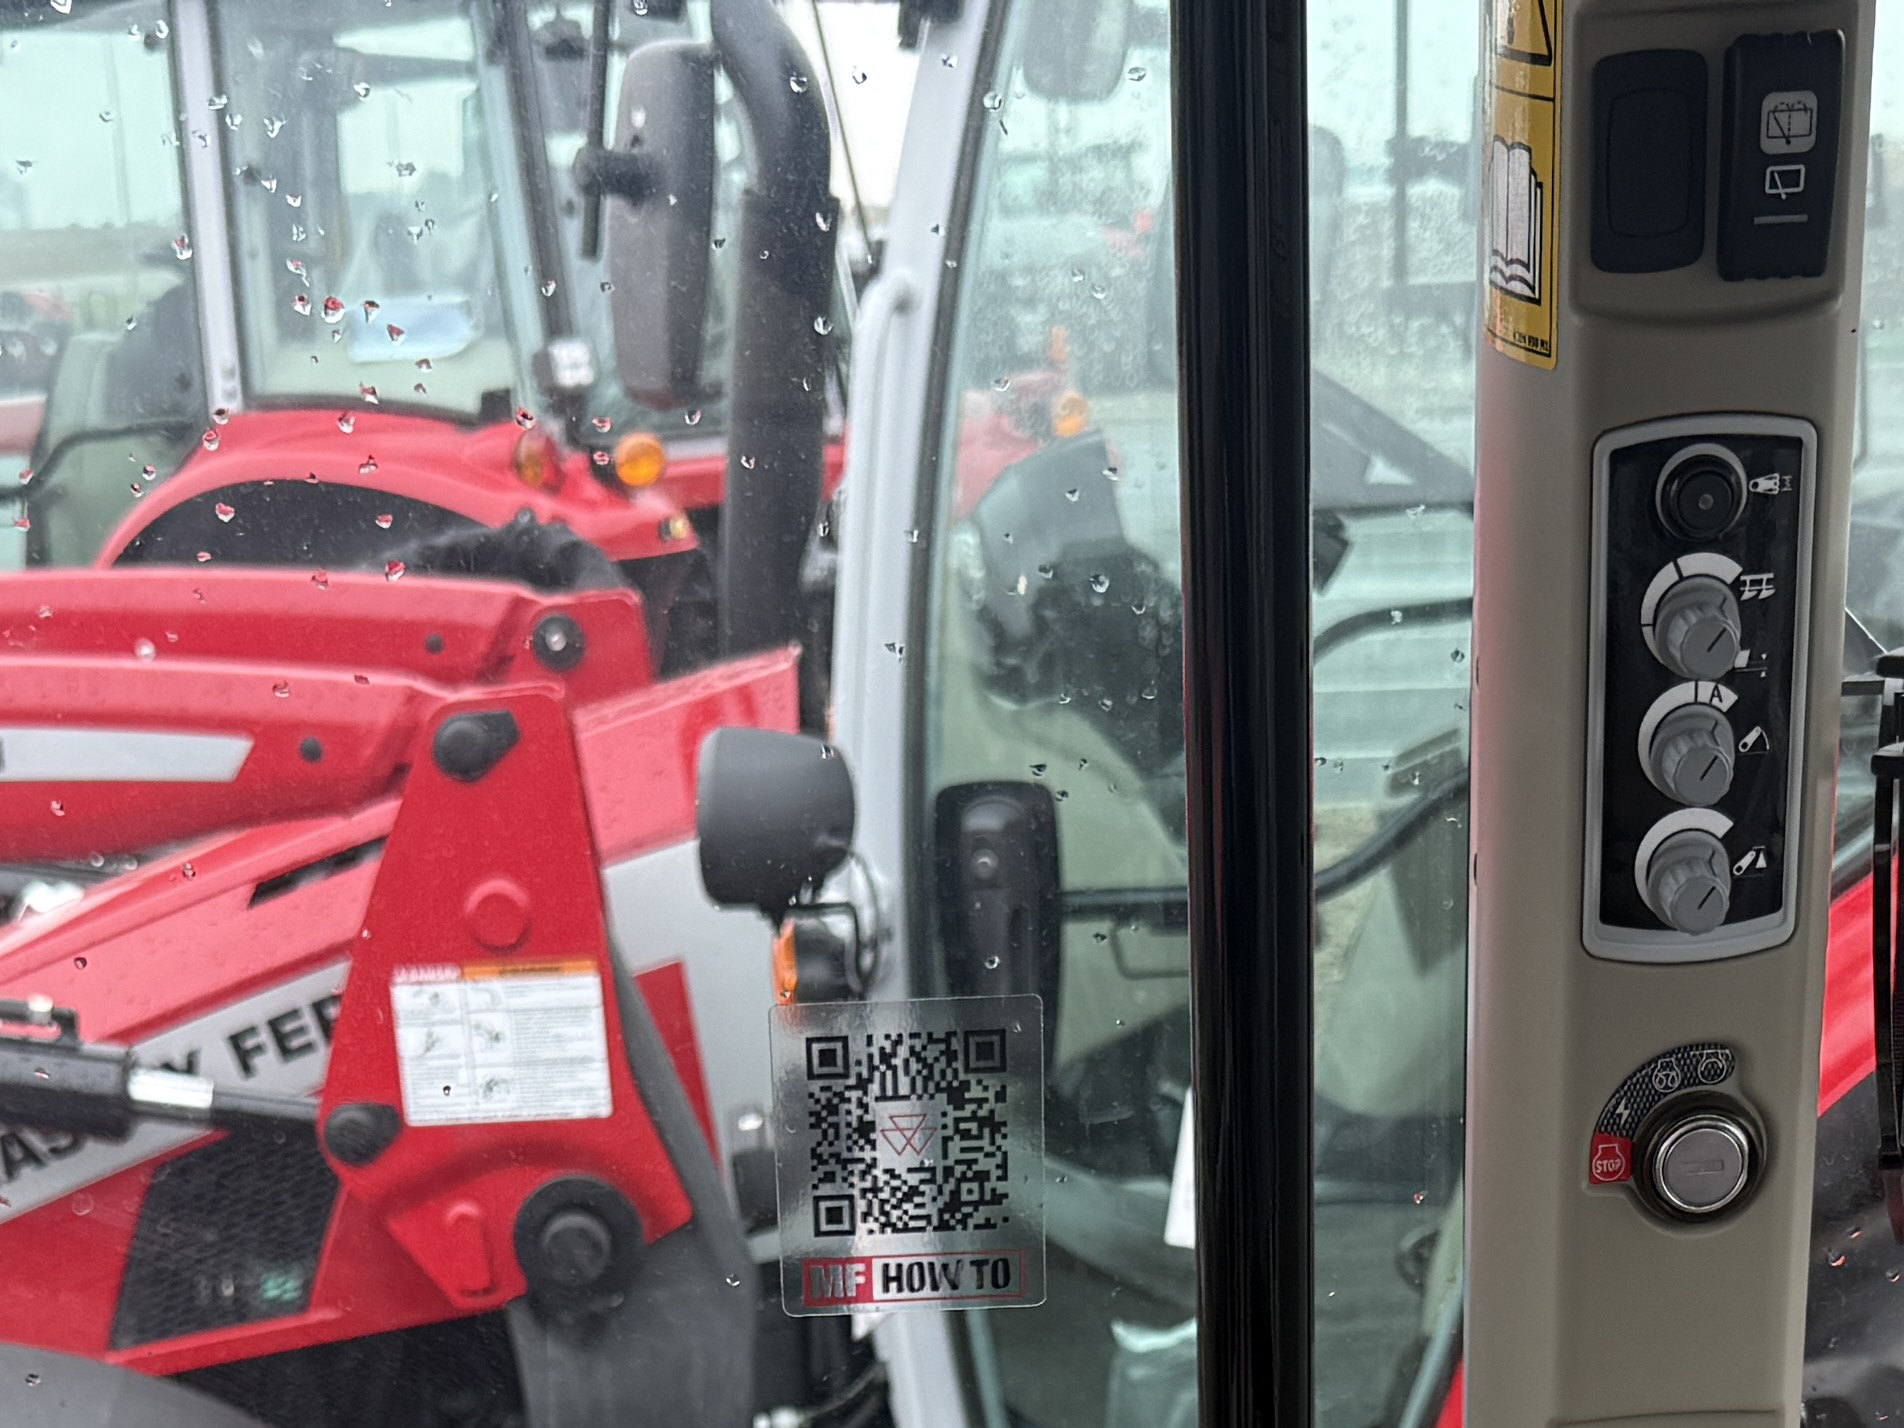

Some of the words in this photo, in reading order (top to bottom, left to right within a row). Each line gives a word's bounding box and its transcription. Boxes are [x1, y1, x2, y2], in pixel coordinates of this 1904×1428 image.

[1596, 1159, 1621, 1173] STOP
[810, 1263, 866, 1298] MF
[881, 1259, 963, 1294] HOW
[970, 1257, 1011, 1290] TO
